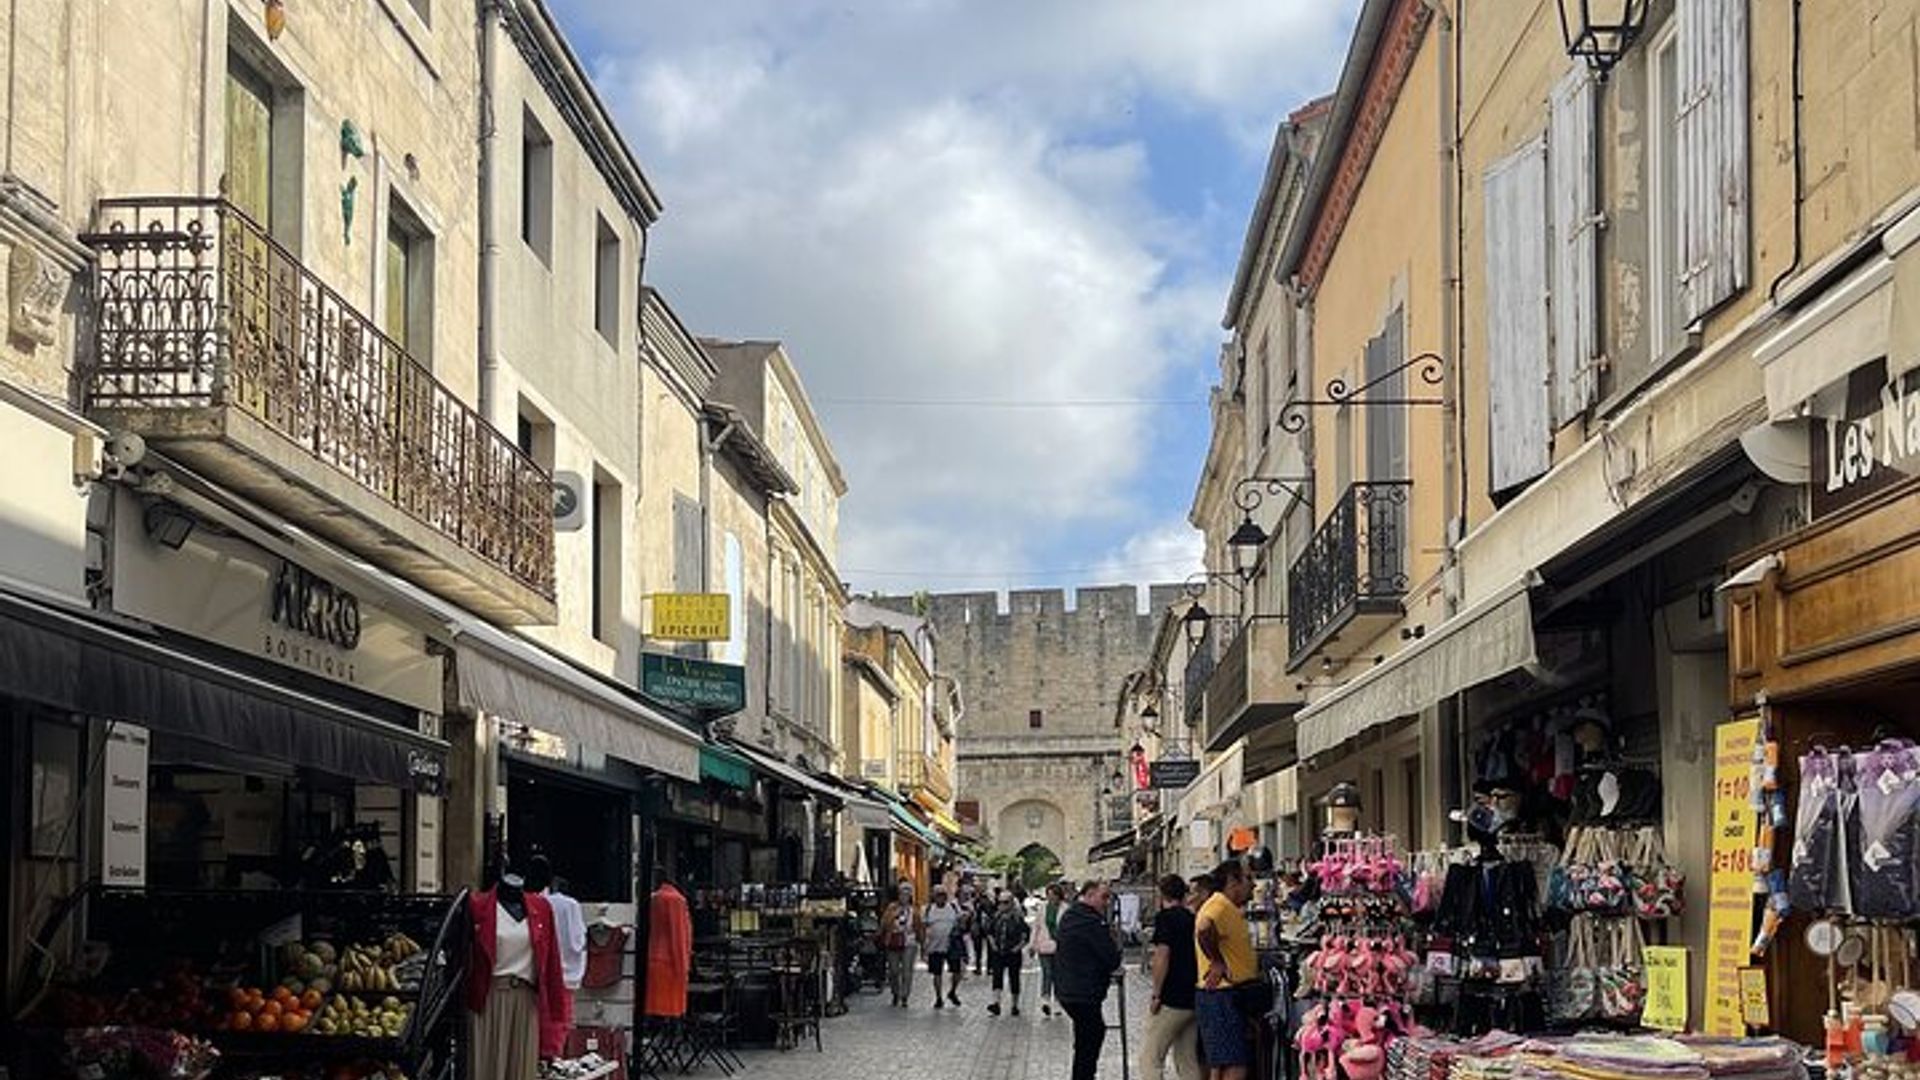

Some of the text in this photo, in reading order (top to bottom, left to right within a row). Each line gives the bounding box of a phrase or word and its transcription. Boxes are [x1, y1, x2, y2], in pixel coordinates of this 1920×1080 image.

[1826, 415, 1874, 493] Les
[660, 624, 720, 635] EPICERIE
[265, 635, 355, 683] BOUTIQUE
